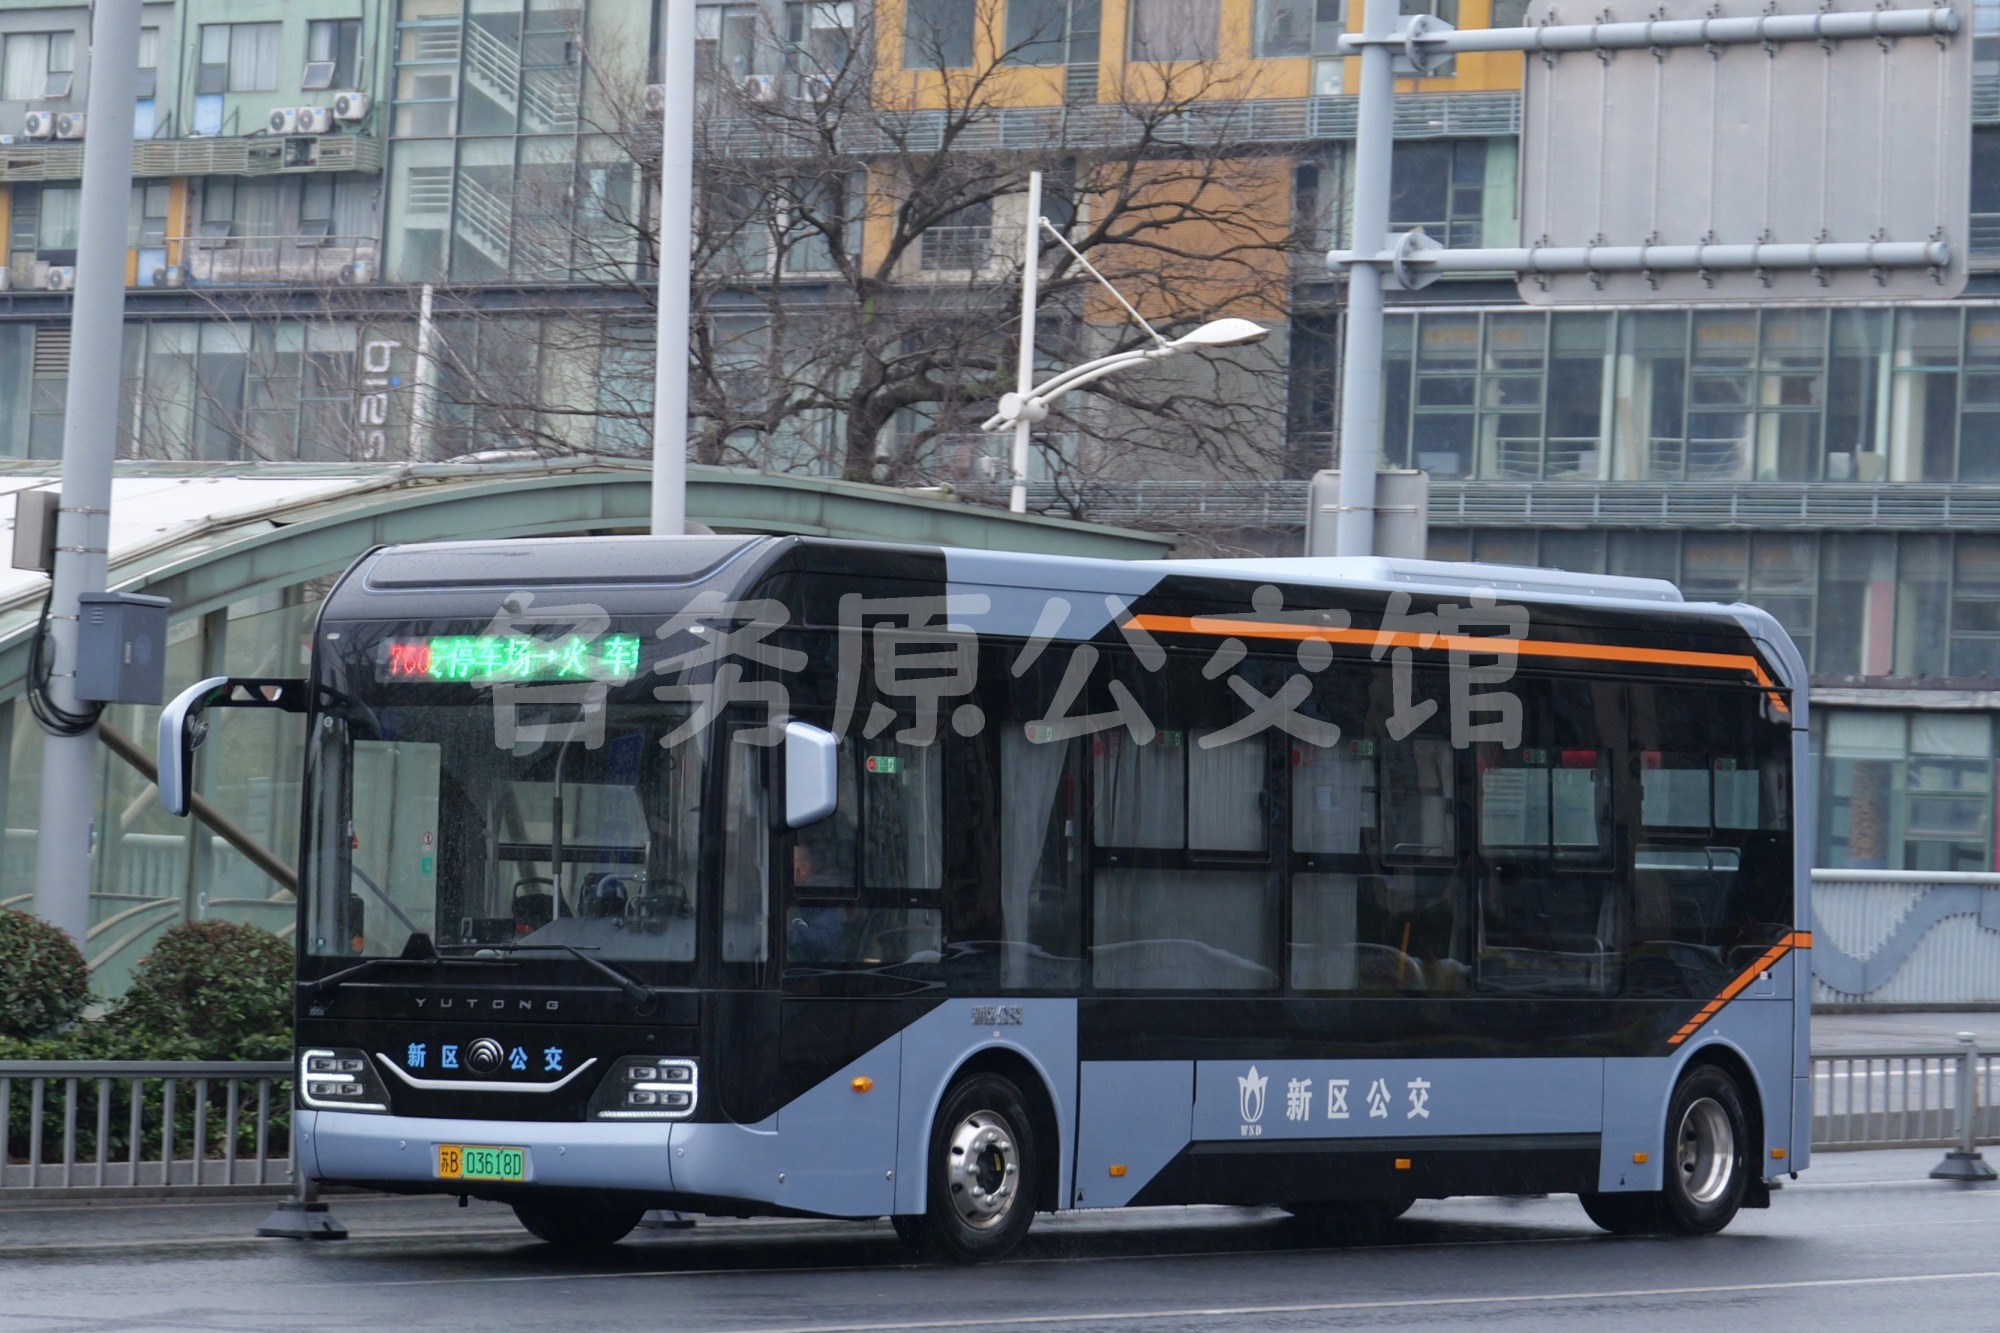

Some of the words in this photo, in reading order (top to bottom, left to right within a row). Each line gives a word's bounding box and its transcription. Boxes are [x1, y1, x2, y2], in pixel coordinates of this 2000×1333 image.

[388, 641, 431, 677] 760
[414, 997, 561, 1011] YUTONG
[1285, 1076, 1432, 1122] 新区公交
[1240, 1125, 1262, 1137] WSD
